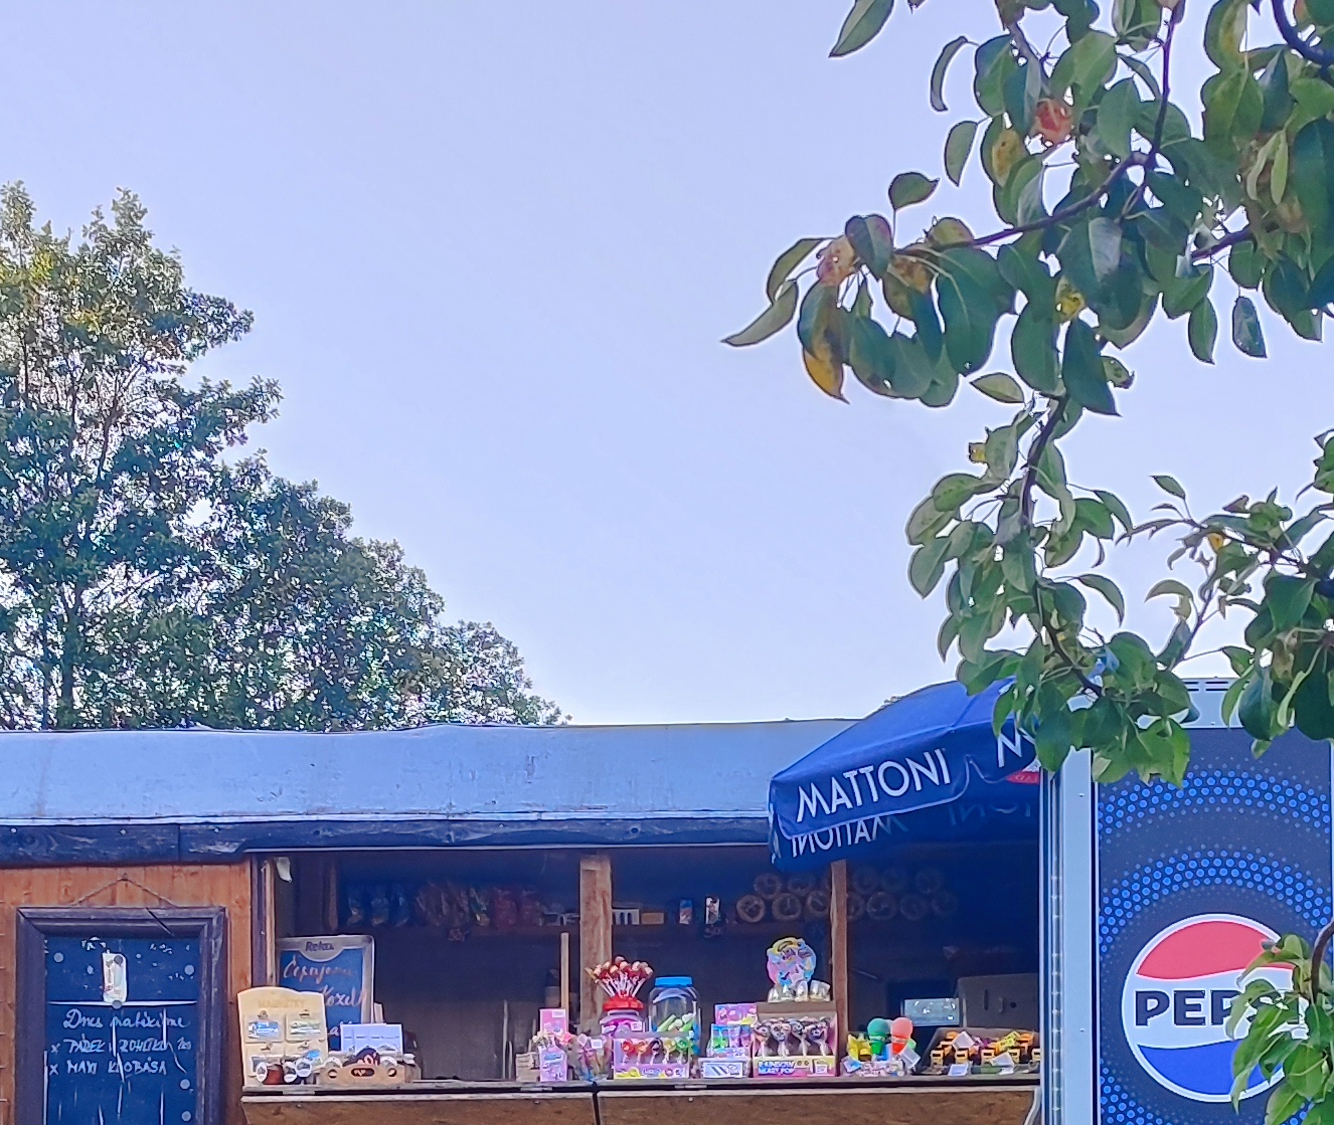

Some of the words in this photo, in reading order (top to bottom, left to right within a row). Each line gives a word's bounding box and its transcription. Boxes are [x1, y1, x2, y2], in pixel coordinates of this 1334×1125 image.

[796, 748, 951, 823] MATTONI
[63, 1008, 103, 1029] Dnes
[1135, 989, 1299, 1027] PEP
